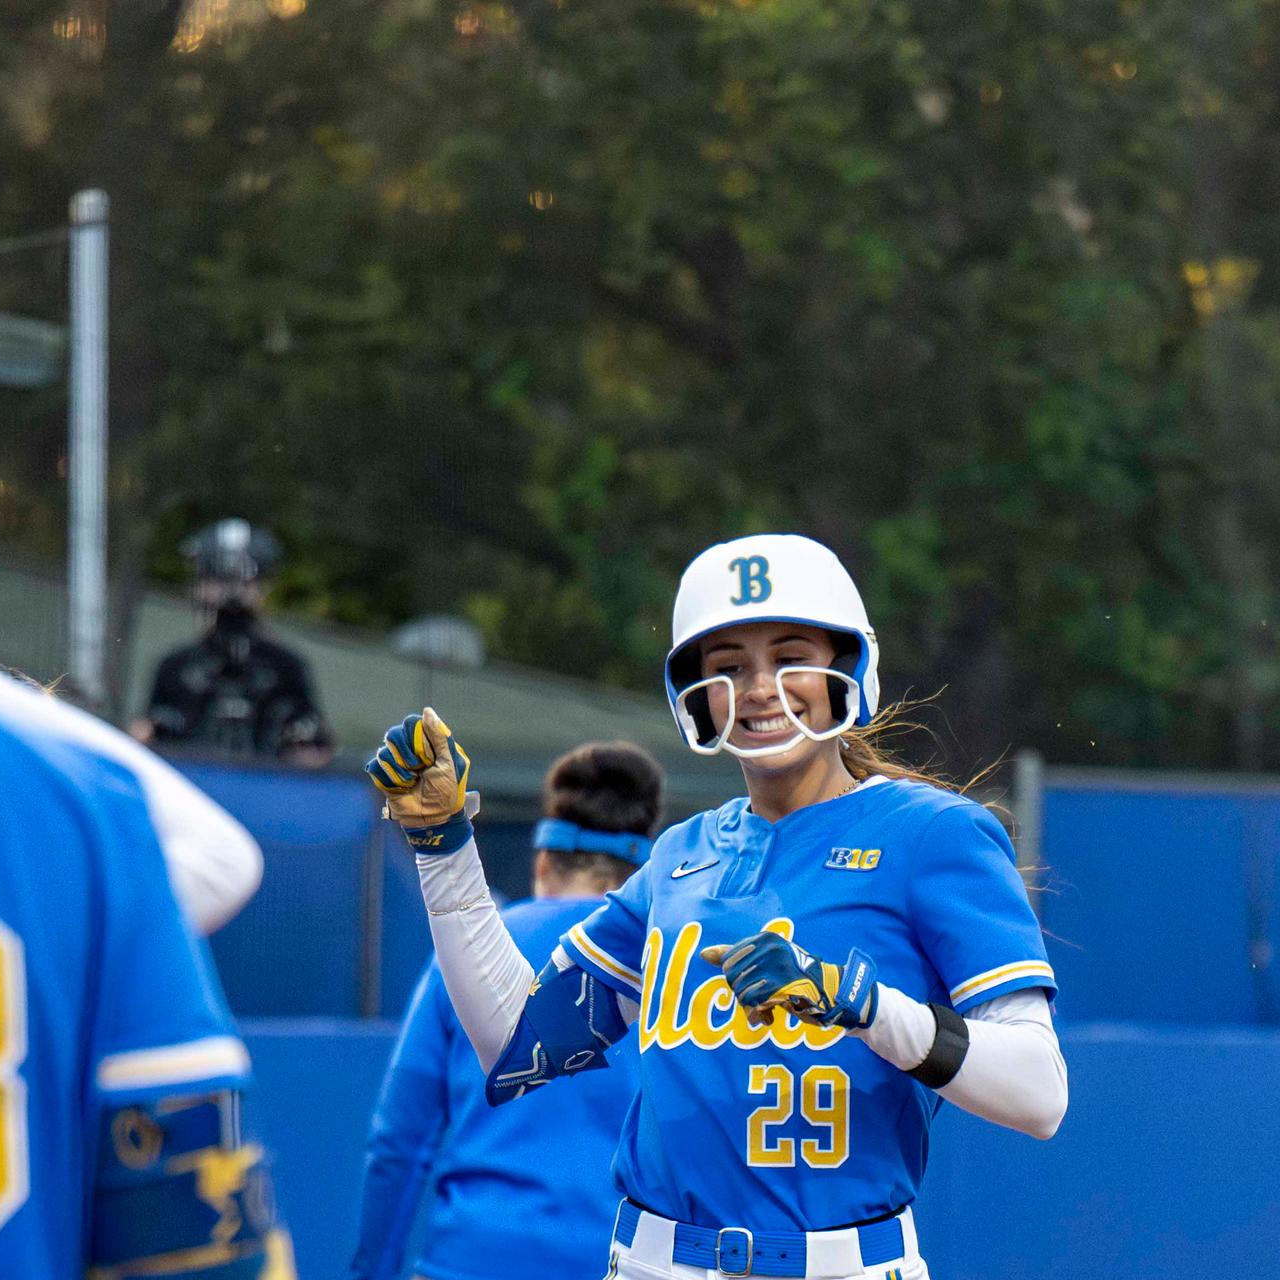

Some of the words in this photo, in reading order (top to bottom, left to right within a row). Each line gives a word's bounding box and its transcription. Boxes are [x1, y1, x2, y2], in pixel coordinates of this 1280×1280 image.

[728, 555, 772, 607] B
[849, 961, 866, 1002] EASTON
[746, 1063, 851, 1169] 29
